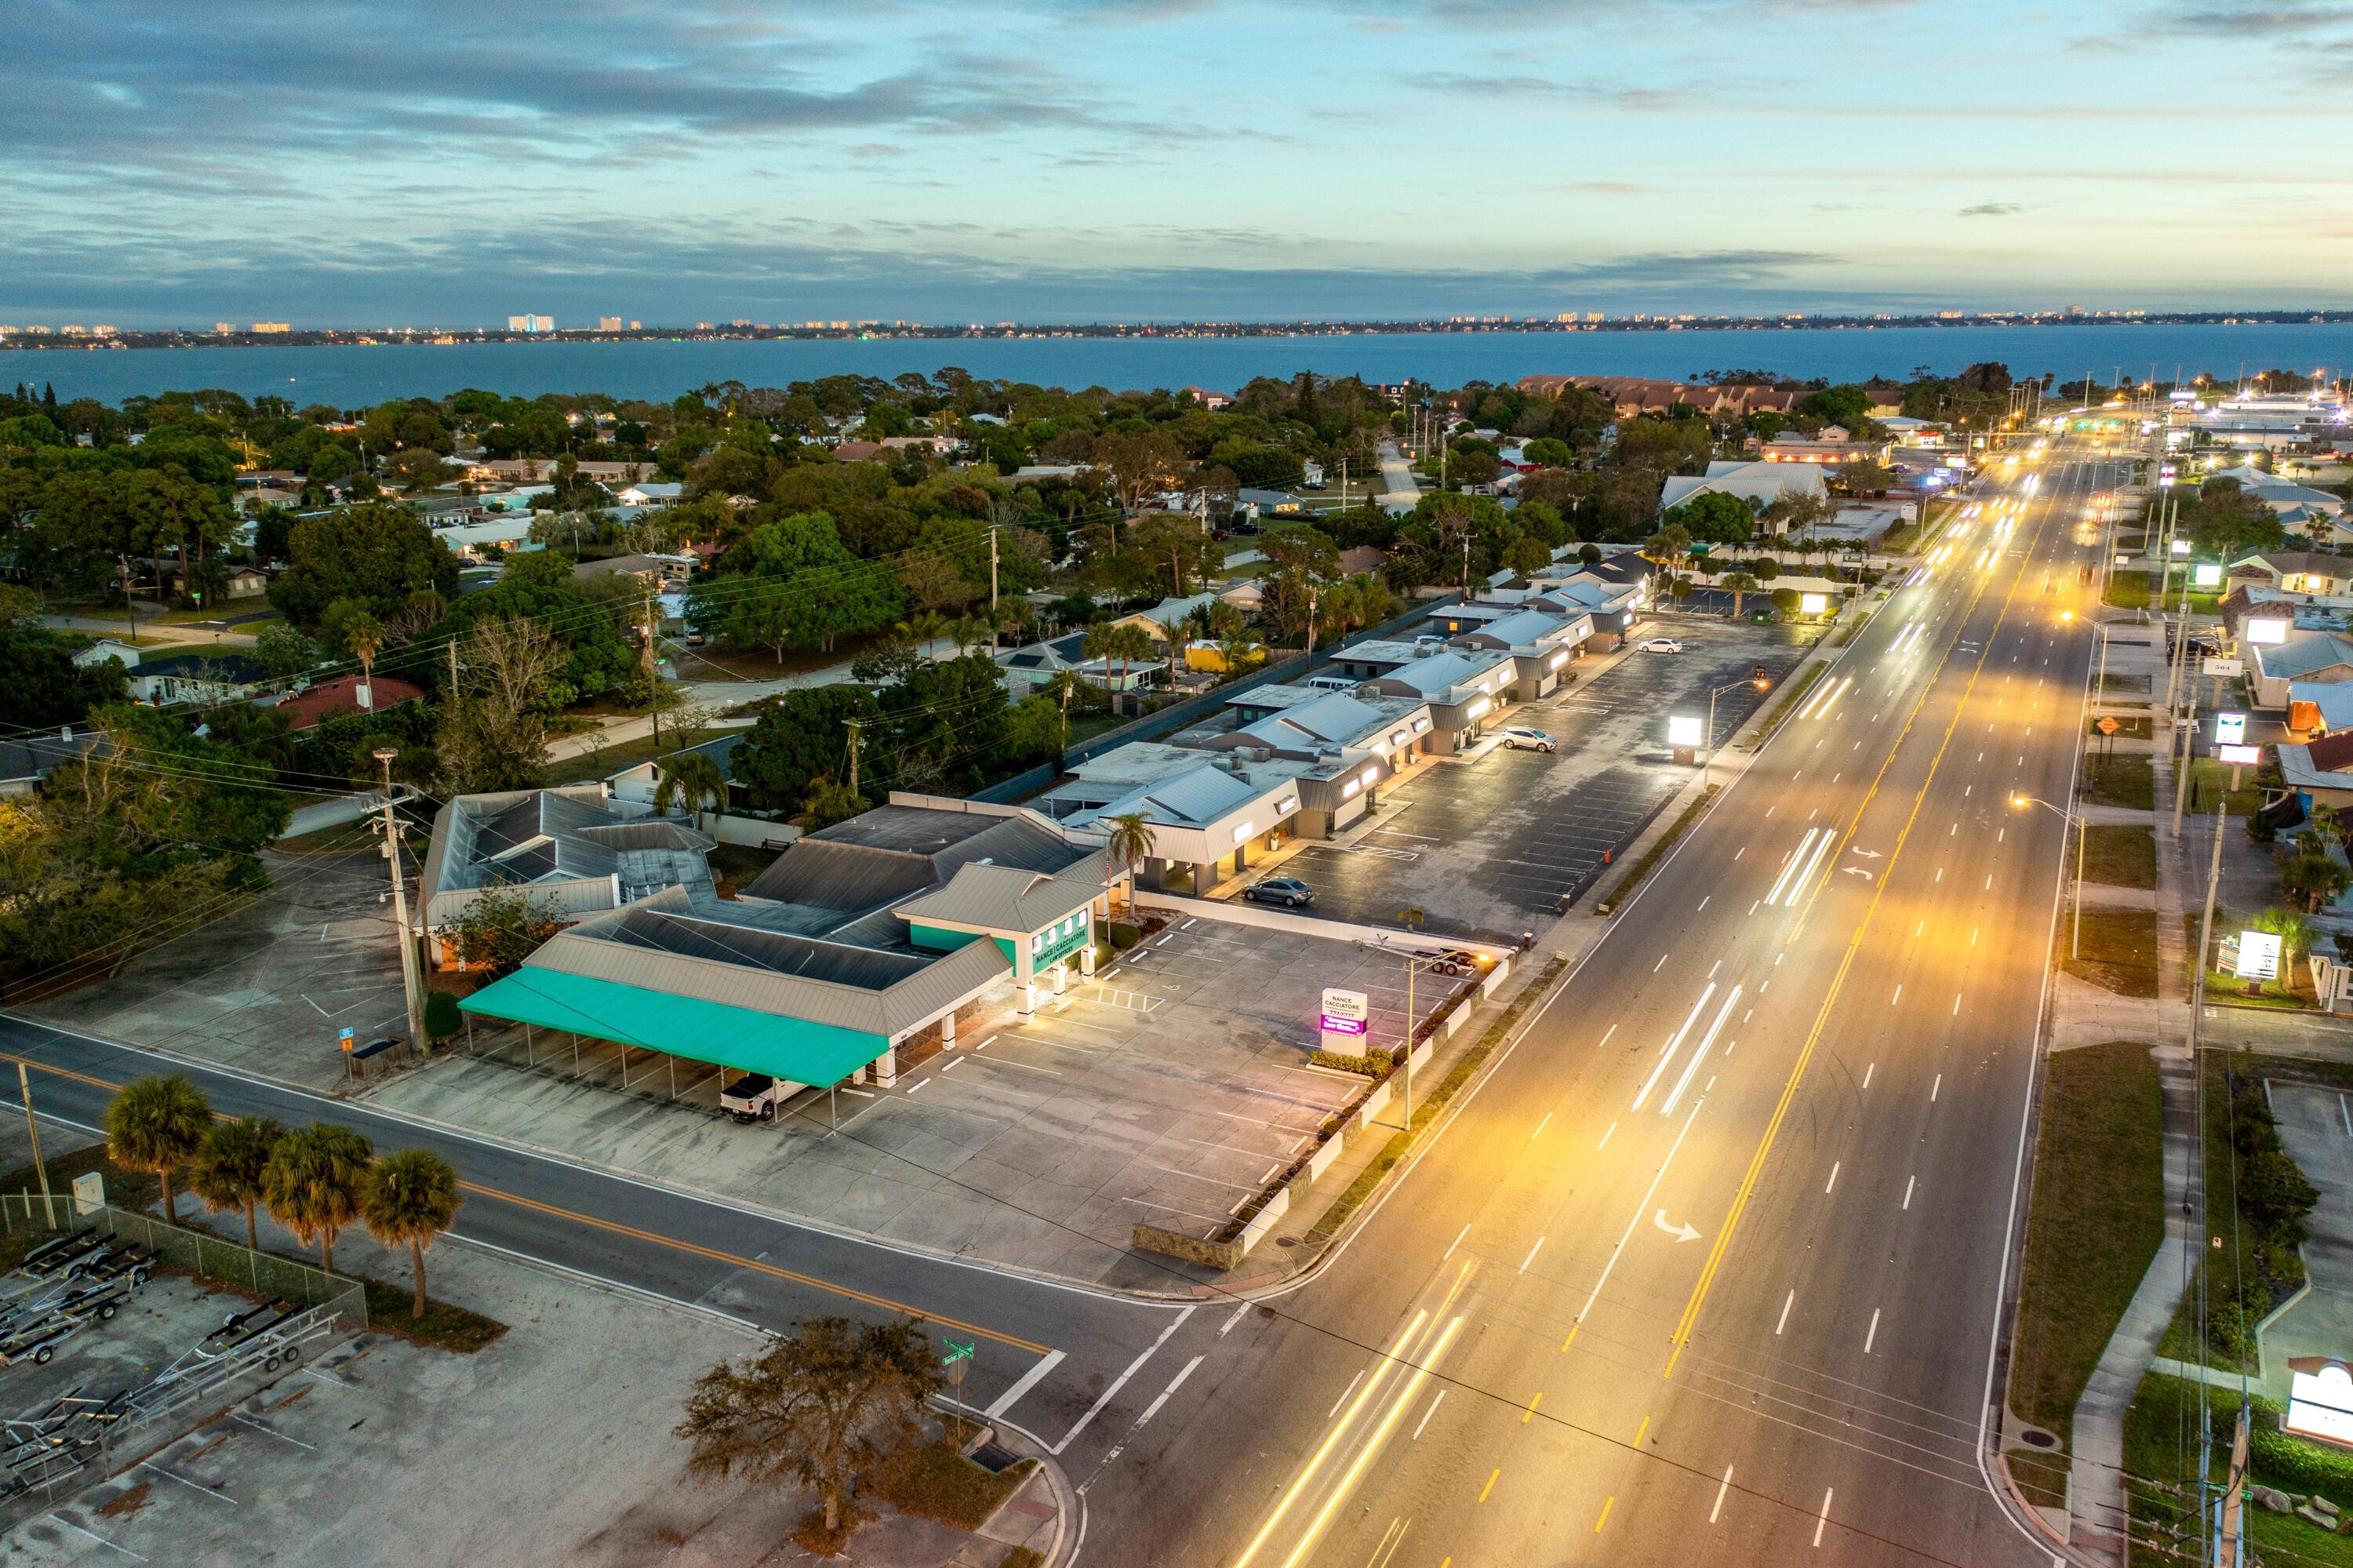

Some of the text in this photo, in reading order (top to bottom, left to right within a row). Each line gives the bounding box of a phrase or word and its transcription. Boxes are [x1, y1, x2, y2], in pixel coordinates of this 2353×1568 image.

[1036, 930, 1086, 963] NANCE CACCIATORE
[1058, 945, 1074, 958] OFFICES
[1325, 1000, 1360, 1010] CACCIATORE
